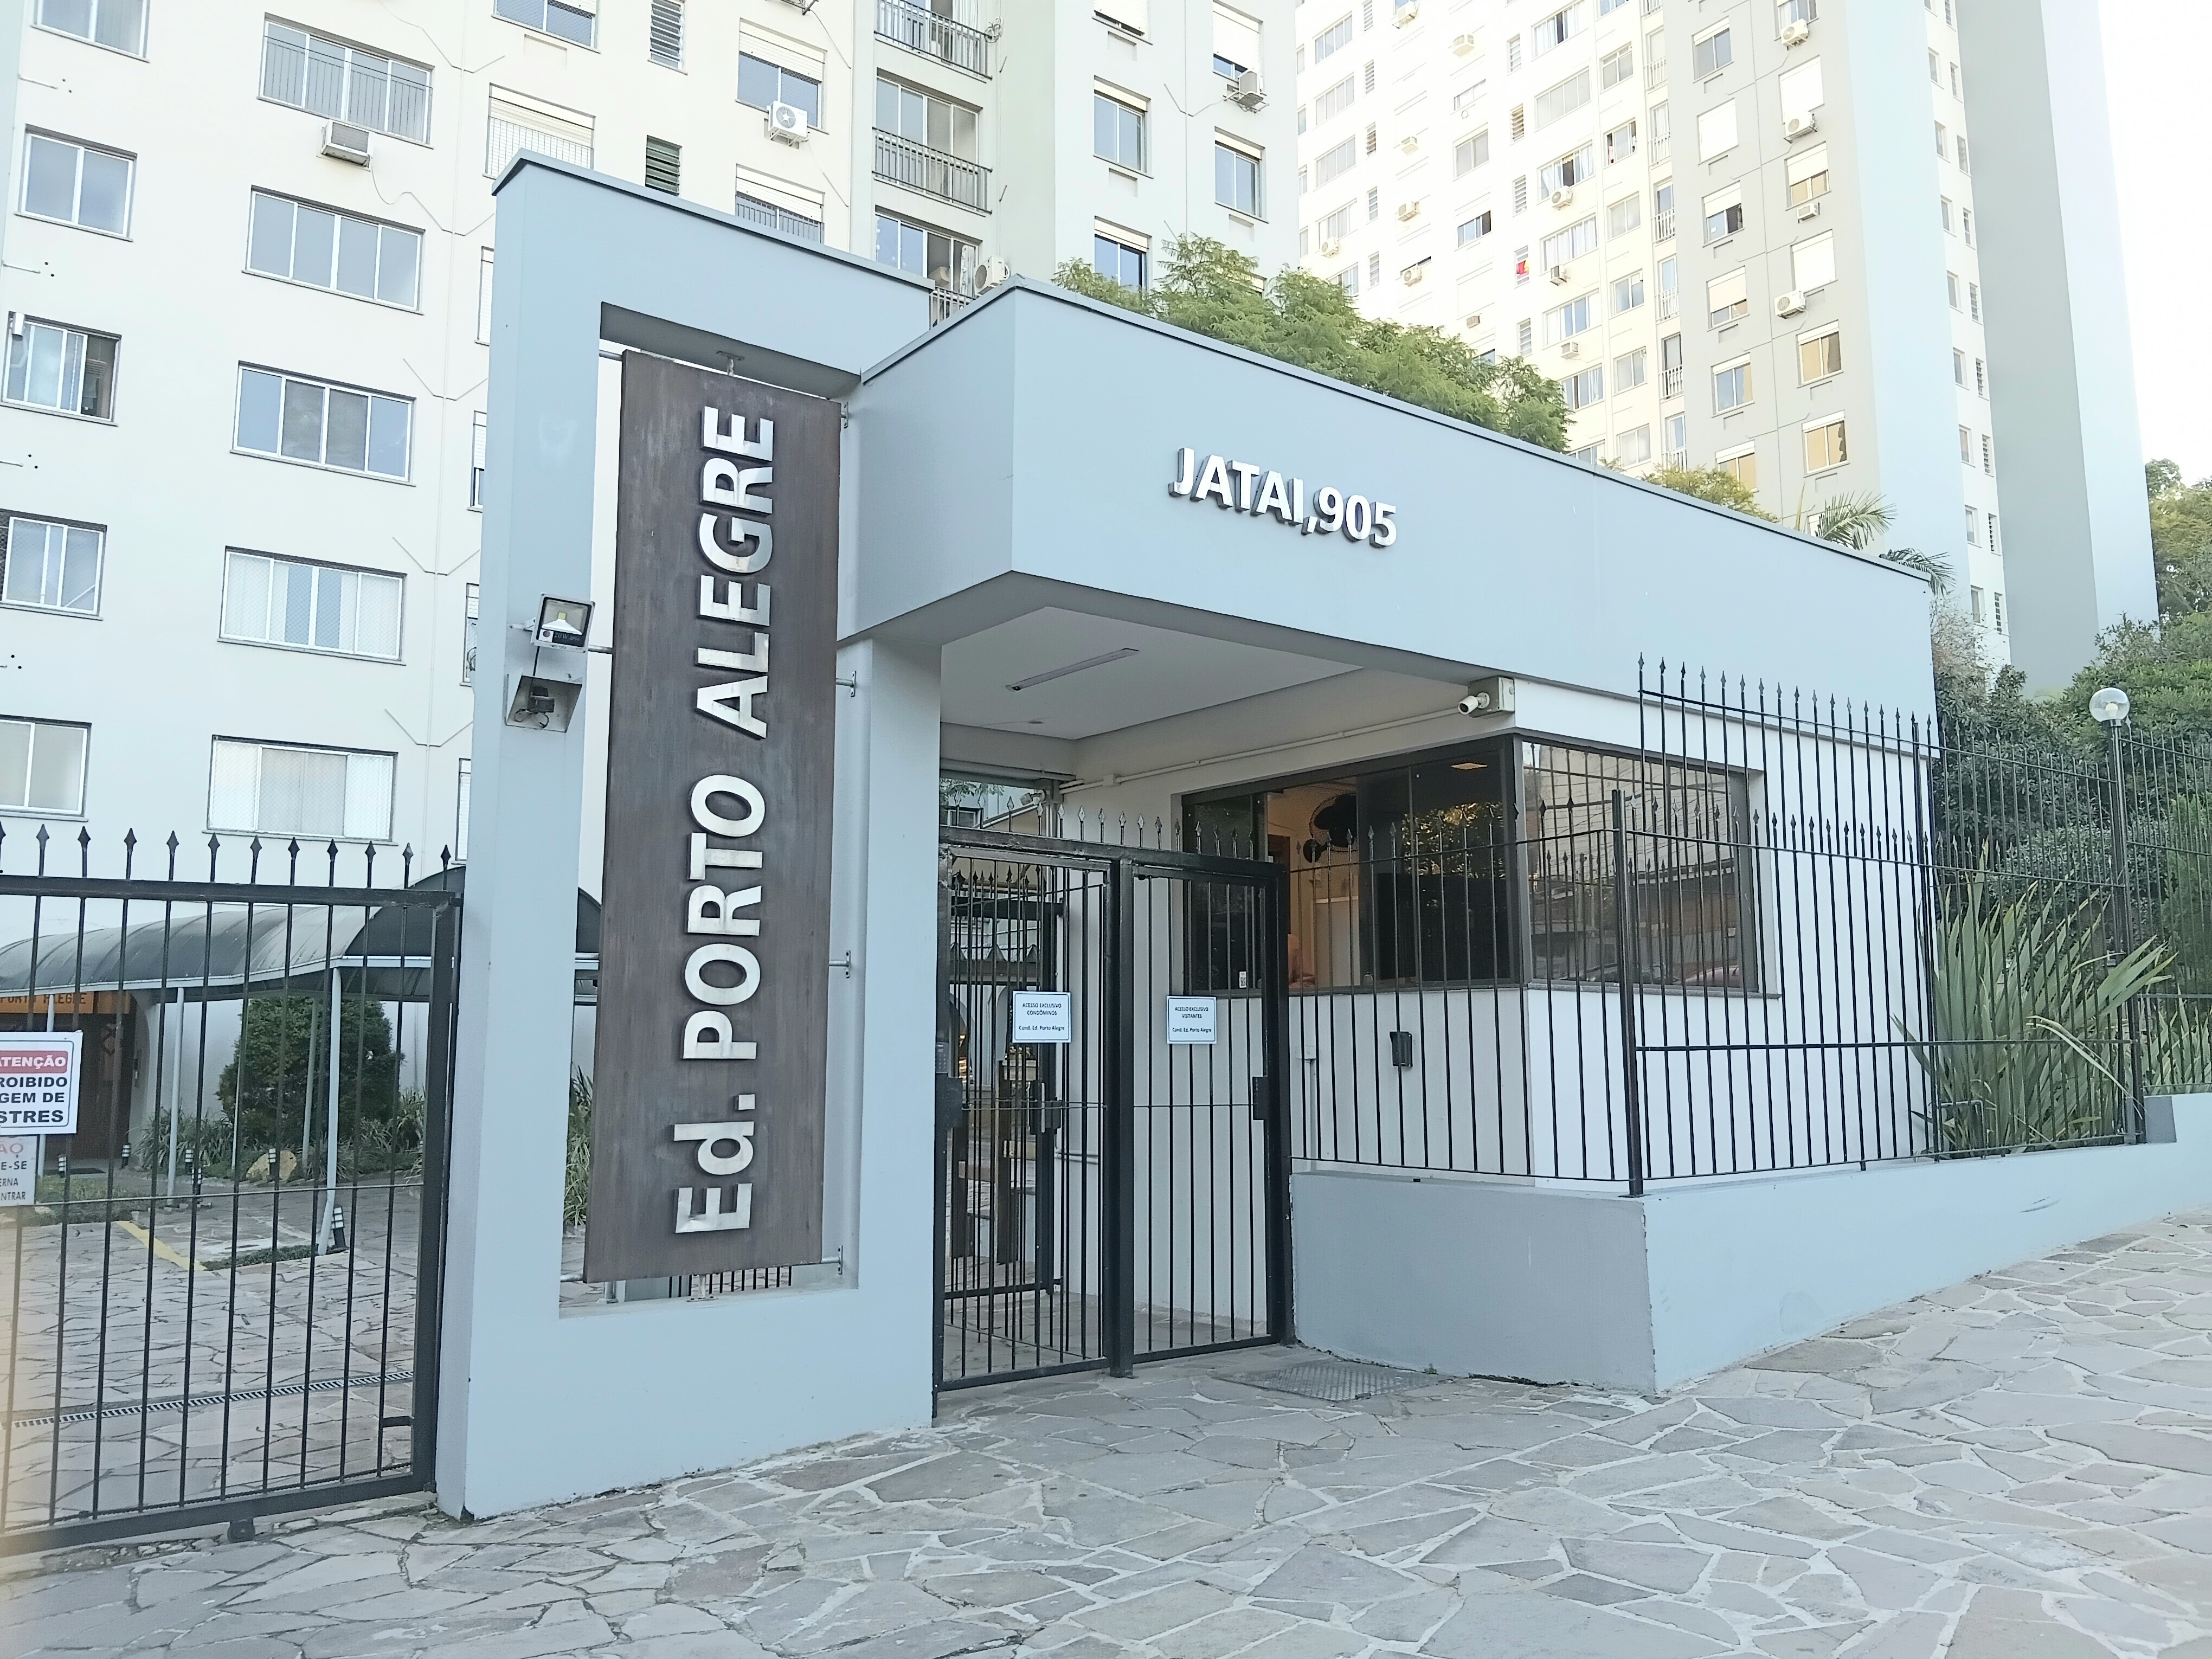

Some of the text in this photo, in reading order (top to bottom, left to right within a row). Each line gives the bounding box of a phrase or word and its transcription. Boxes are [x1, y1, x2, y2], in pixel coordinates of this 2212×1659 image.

[1168, 447, 1397, 548] JATAI,905
[674, 406, 774, 1234] Ed. PORTO ALEGRE
[0, 1054, 66, 1069] TENÇÃO
[42, 1092, 65, 1103] DE
